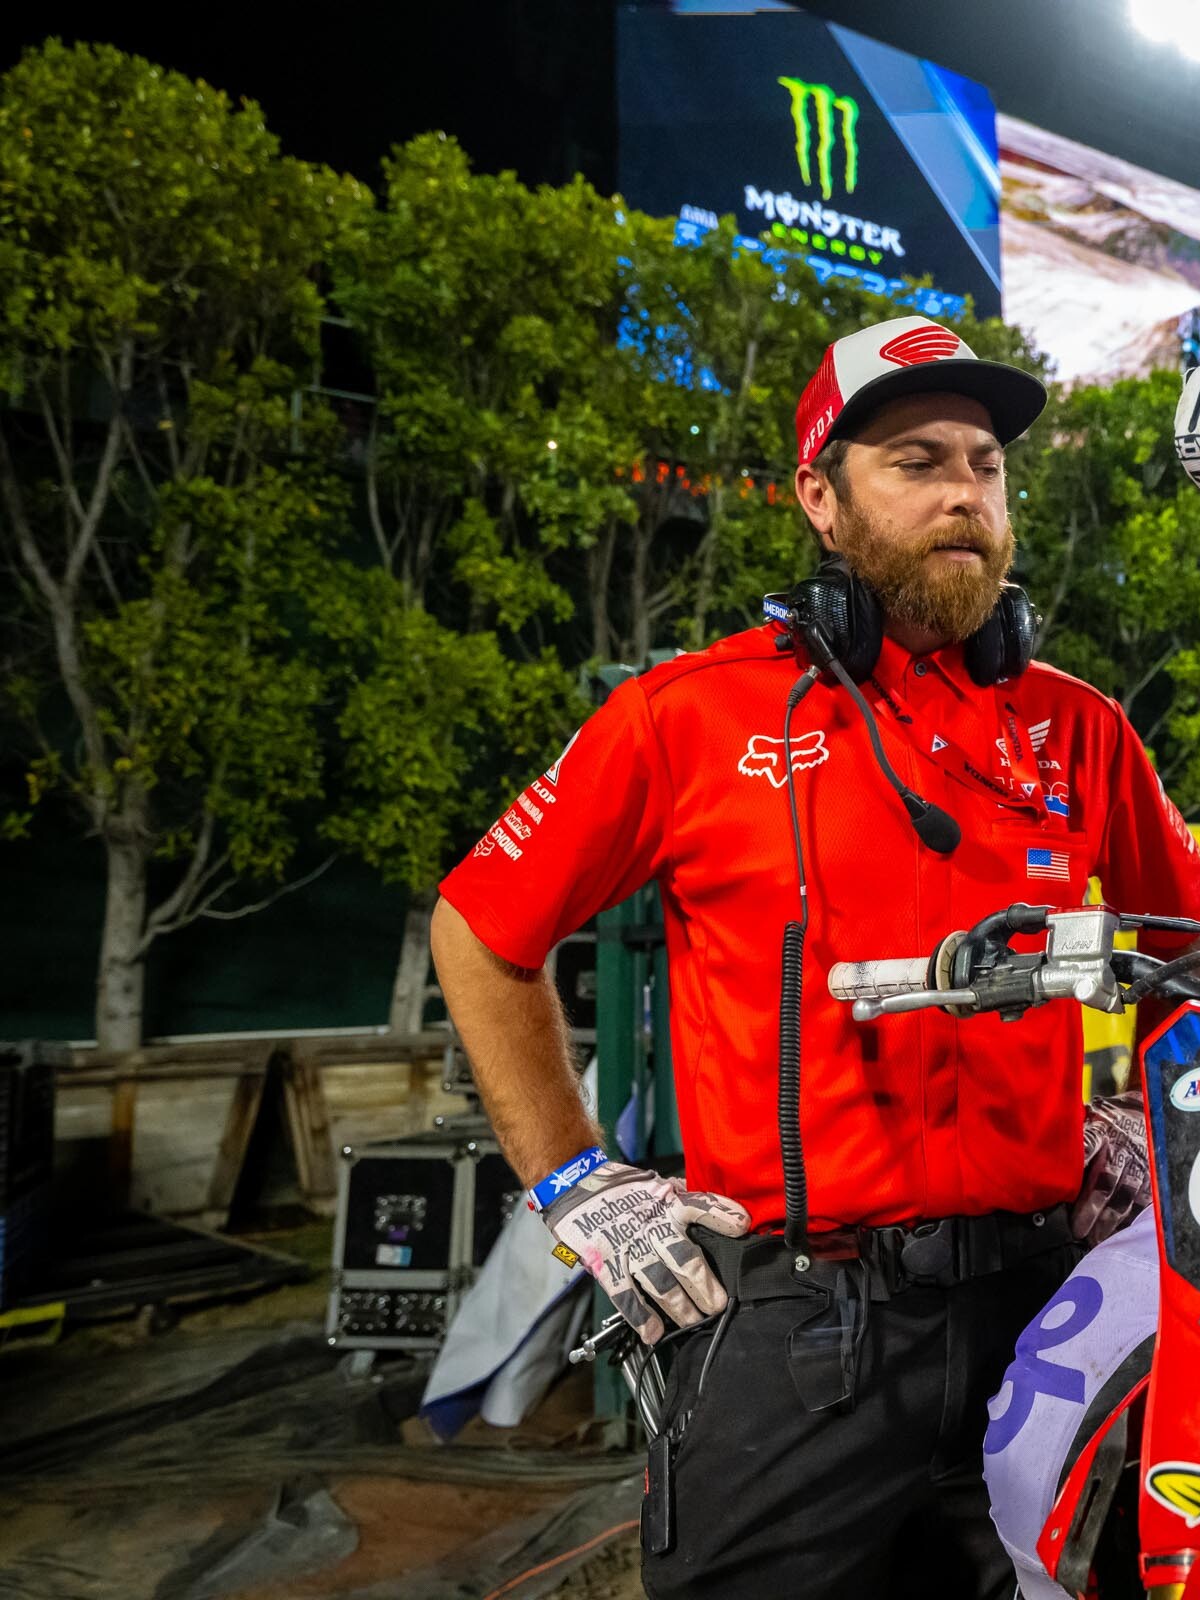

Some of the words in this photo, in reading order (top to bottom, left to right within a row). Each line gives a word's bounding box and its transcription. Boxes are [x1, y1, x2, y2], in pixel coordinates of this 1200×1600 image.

[744, 184, 905, 257] MONSTER
[810, 405, 834, 448] FOX
[1000, 757, 1062, 770] HDA
[491, 824, 523, 862] SHOWA
[573, 1188, 655, 1239] Mechanix
